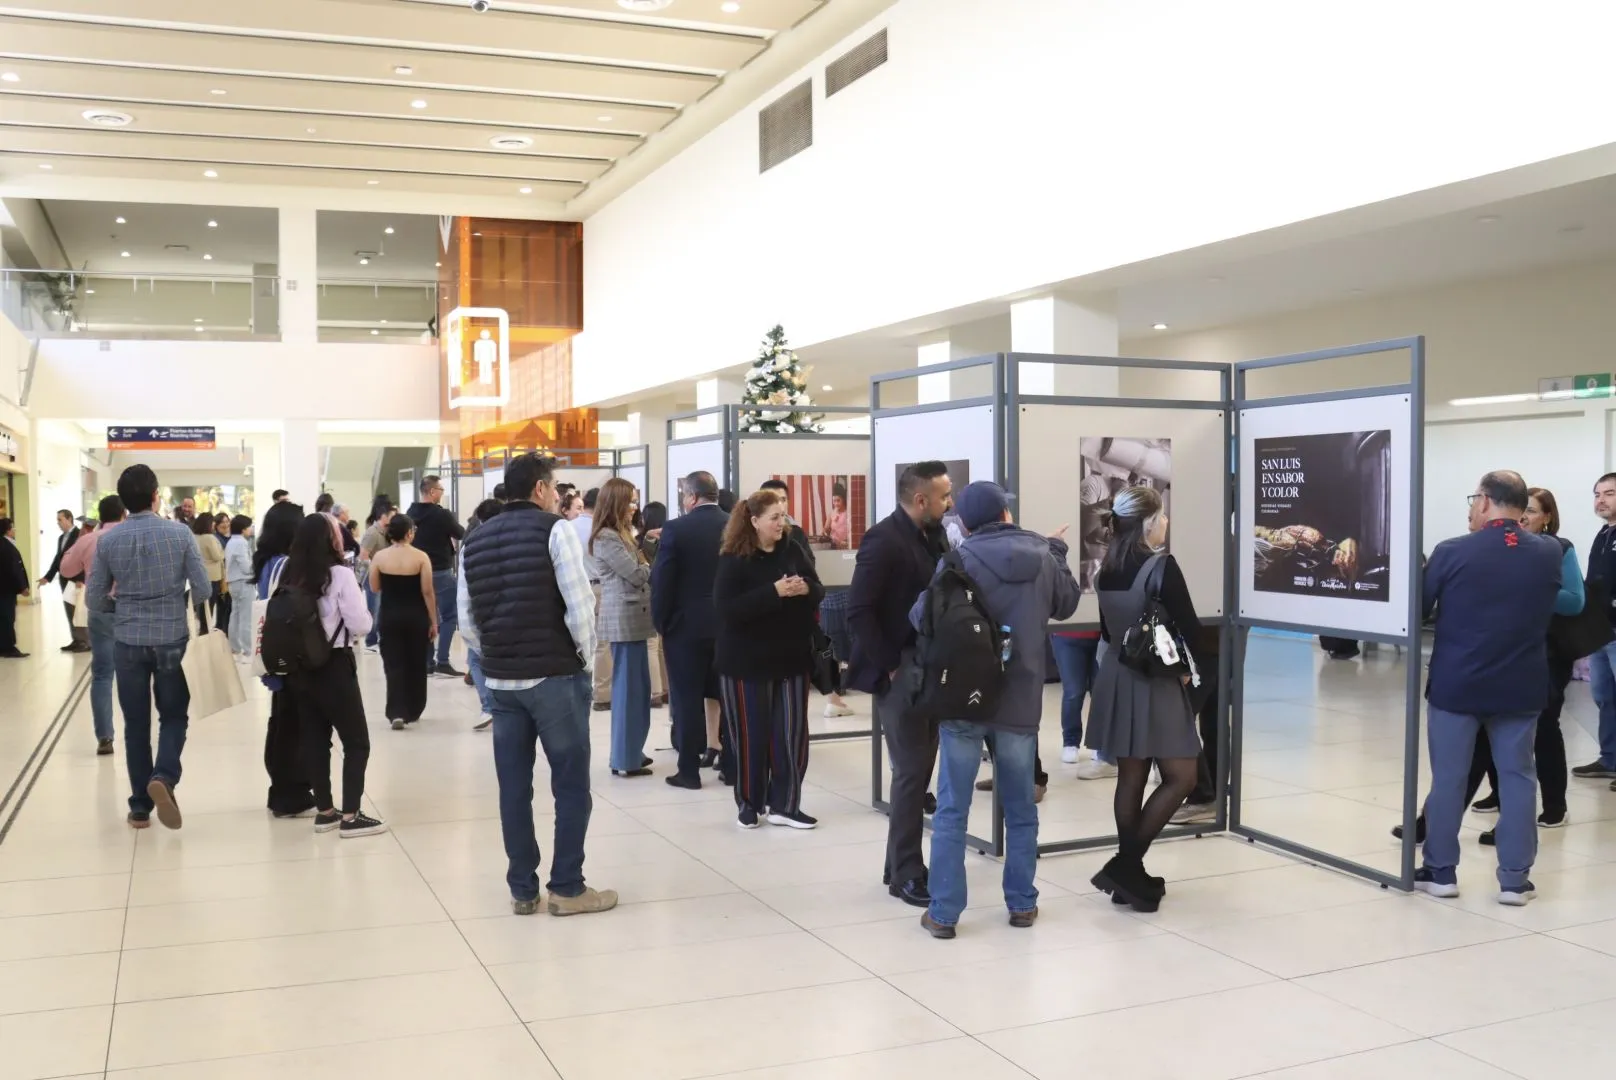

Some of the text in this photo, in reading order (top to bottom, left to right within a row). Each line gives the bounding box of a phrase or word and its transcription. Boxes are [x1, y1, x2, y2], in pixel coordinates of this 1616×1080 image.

[1262, 458, 1301, 470] SAN LUIS
[1262, 472, 1304, 484] EN SABOR
[1262, 486, 1299, 498] Y COLOR
